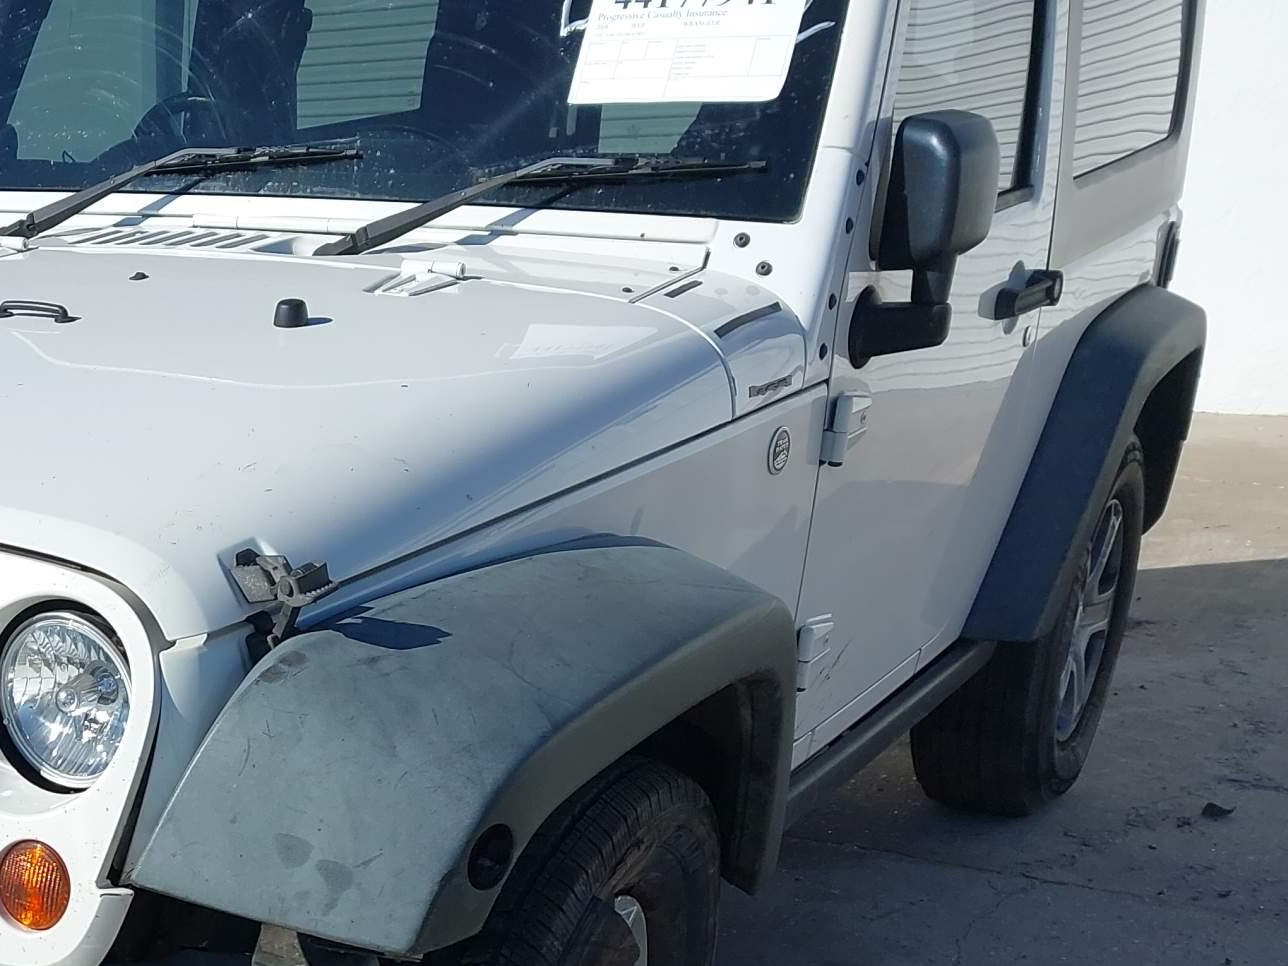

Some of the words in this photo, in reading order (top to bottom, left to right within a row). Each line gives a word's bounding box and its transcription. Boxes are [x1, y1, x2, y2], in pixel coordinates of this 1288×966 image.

[598, 12, 646, 22] Progressive
[647, 10, 682, 20] Casualty
[686, 8, 728, 17] Insurance
